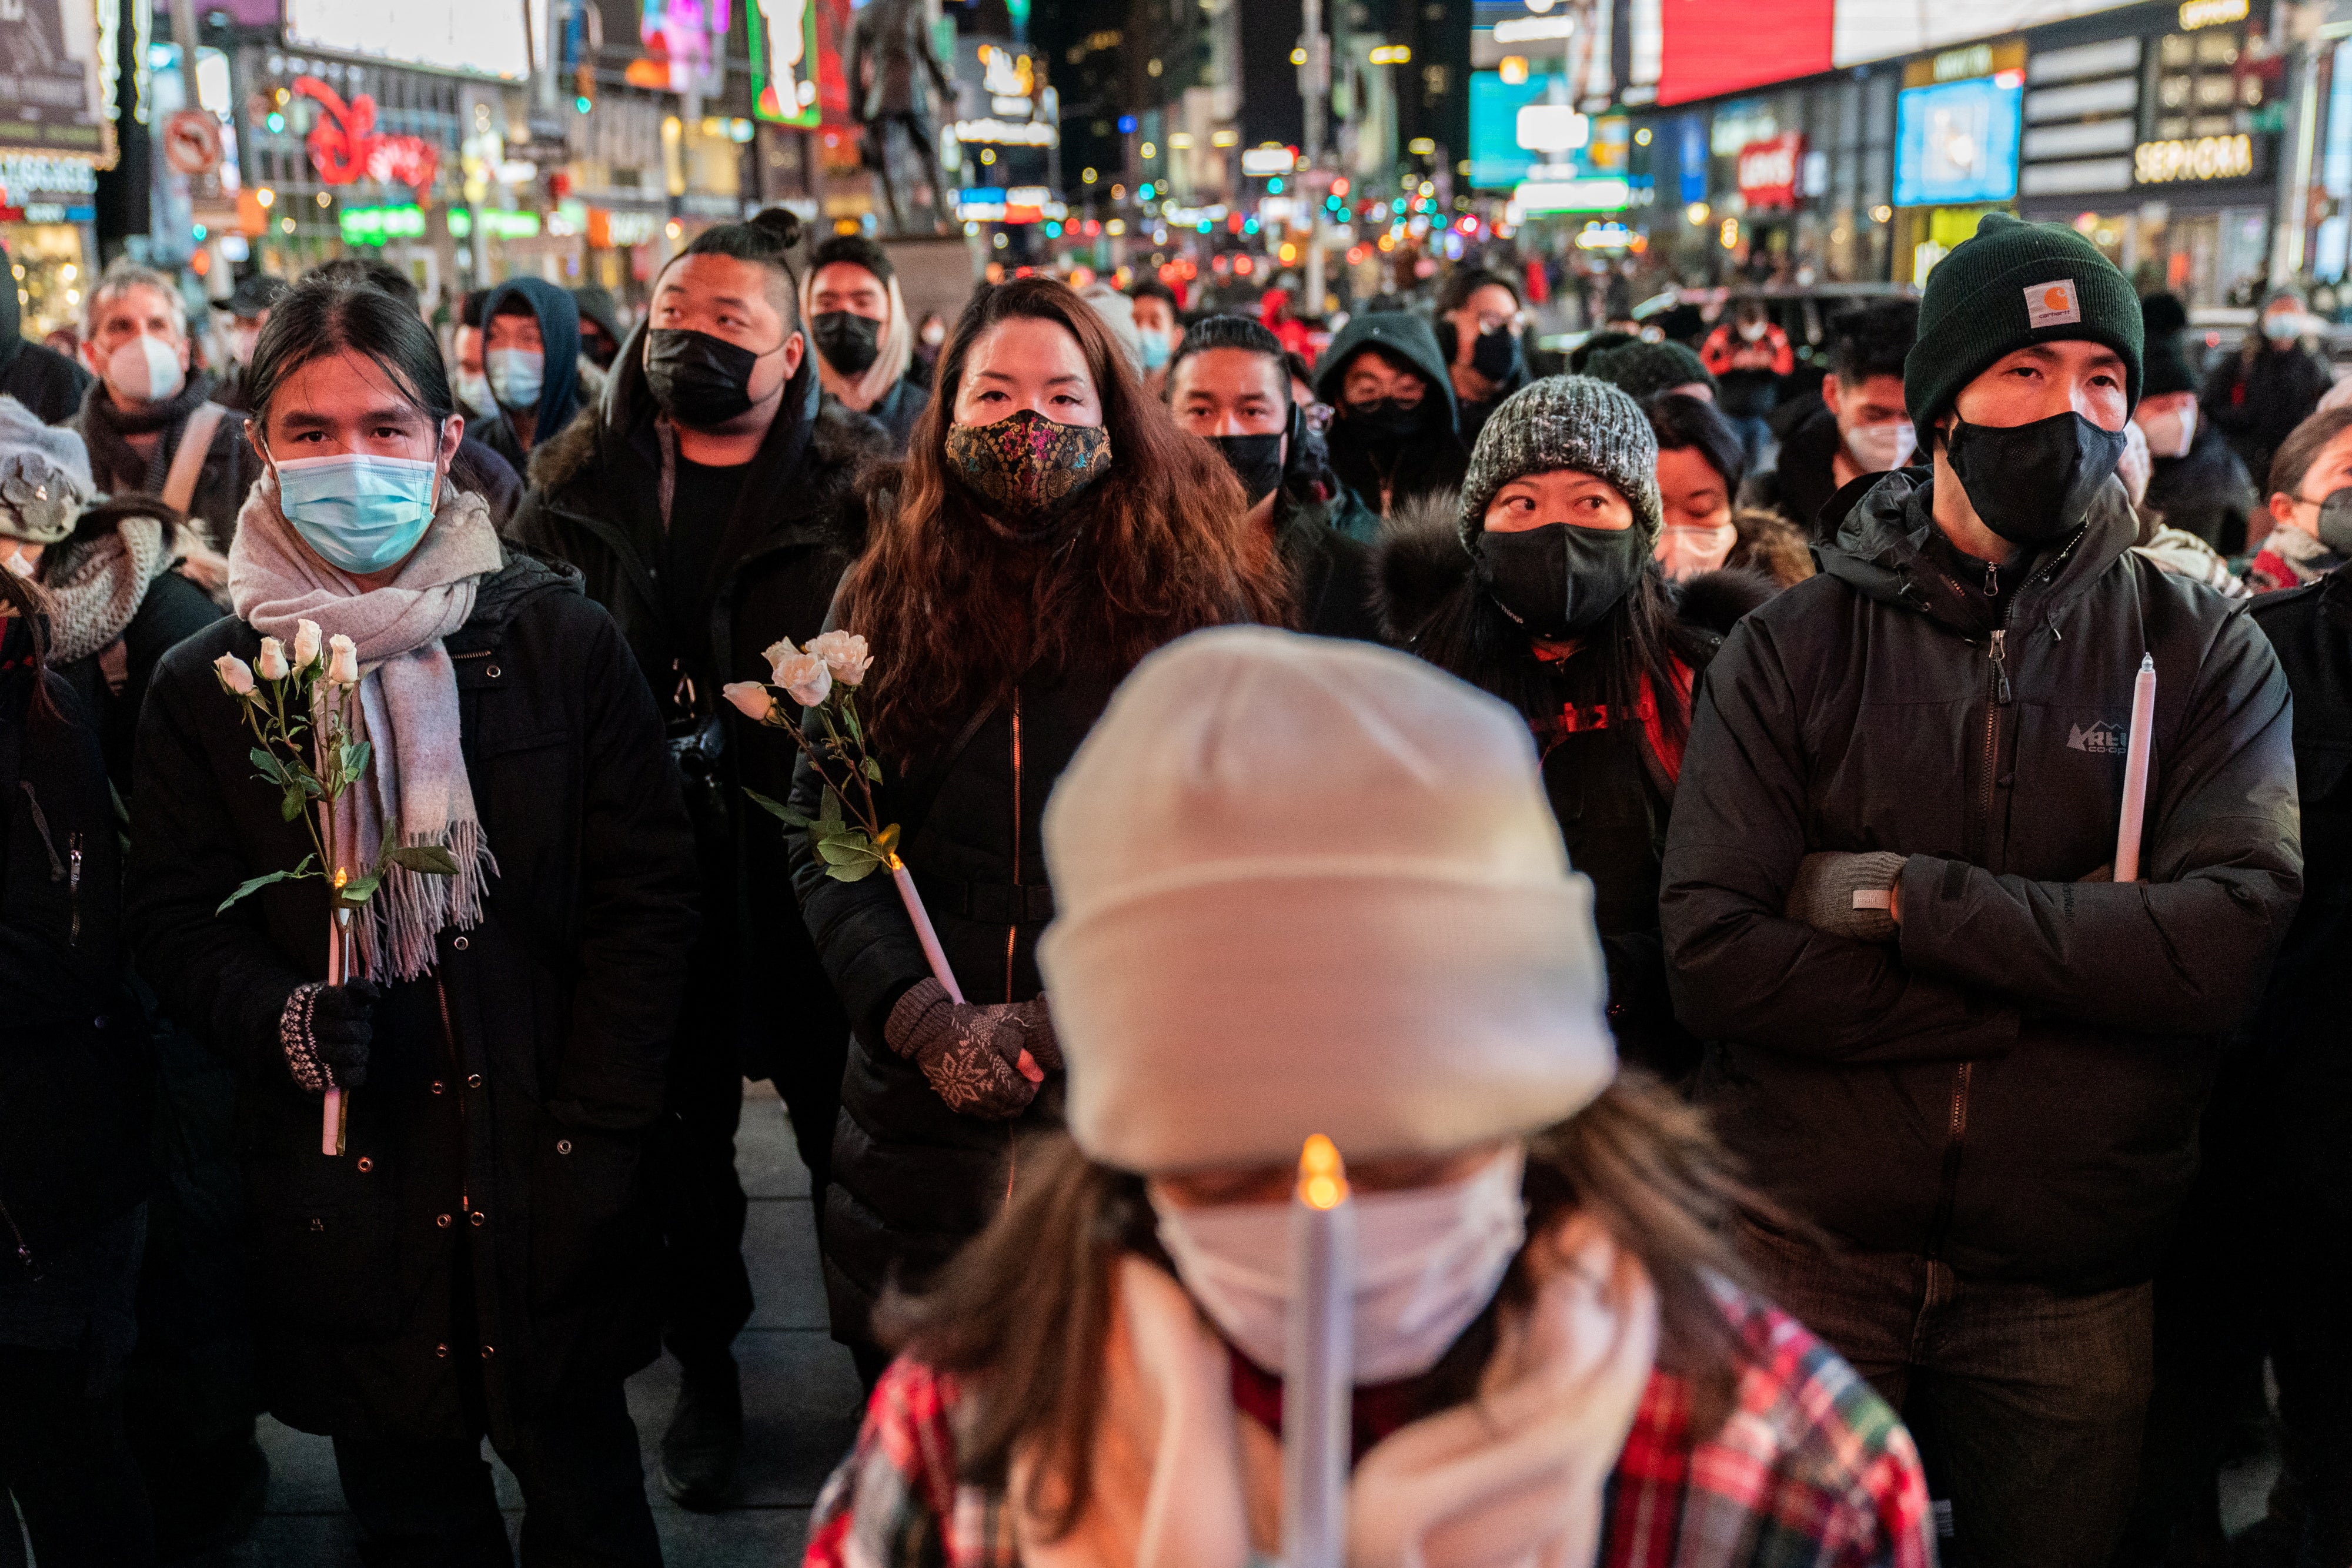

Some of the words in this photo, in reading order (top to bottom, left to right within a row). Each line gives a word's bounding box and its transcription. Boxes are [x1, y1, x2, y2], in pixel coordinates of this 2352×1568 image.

[2039, 310, 2070, 319] carhartt
[2088, 731, 2127, 747] REI
[1857, 894, 1876, 904] moshi
